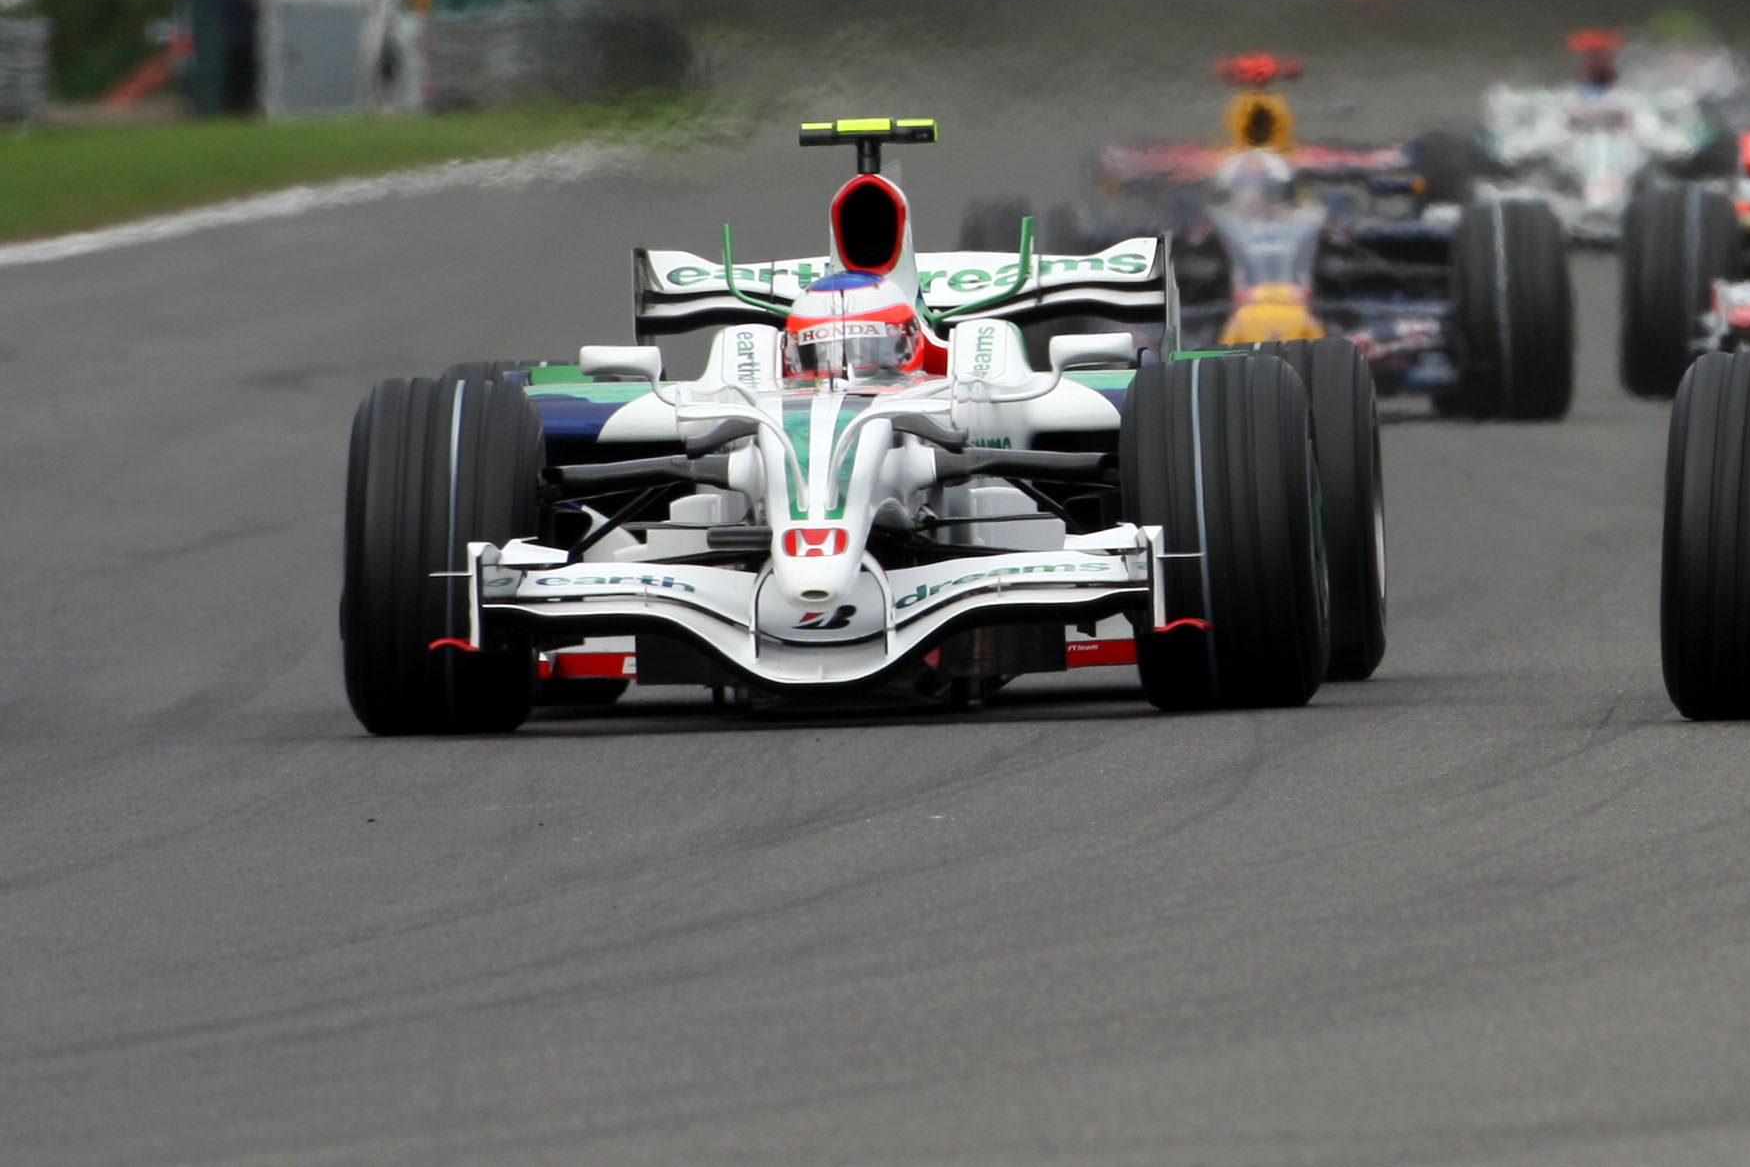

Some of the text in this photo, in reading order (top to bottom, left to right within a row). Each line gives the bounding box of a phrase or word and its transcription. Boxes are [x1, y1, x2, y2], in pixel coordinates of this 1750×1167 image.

[666, 261, 832, 290] eart
[917, 252, 1148, 294] reams
[802, 324, 880, 342] HONDA
[535, 574, 695, 593] earth
[894, 561, 1110, 609] dreams
